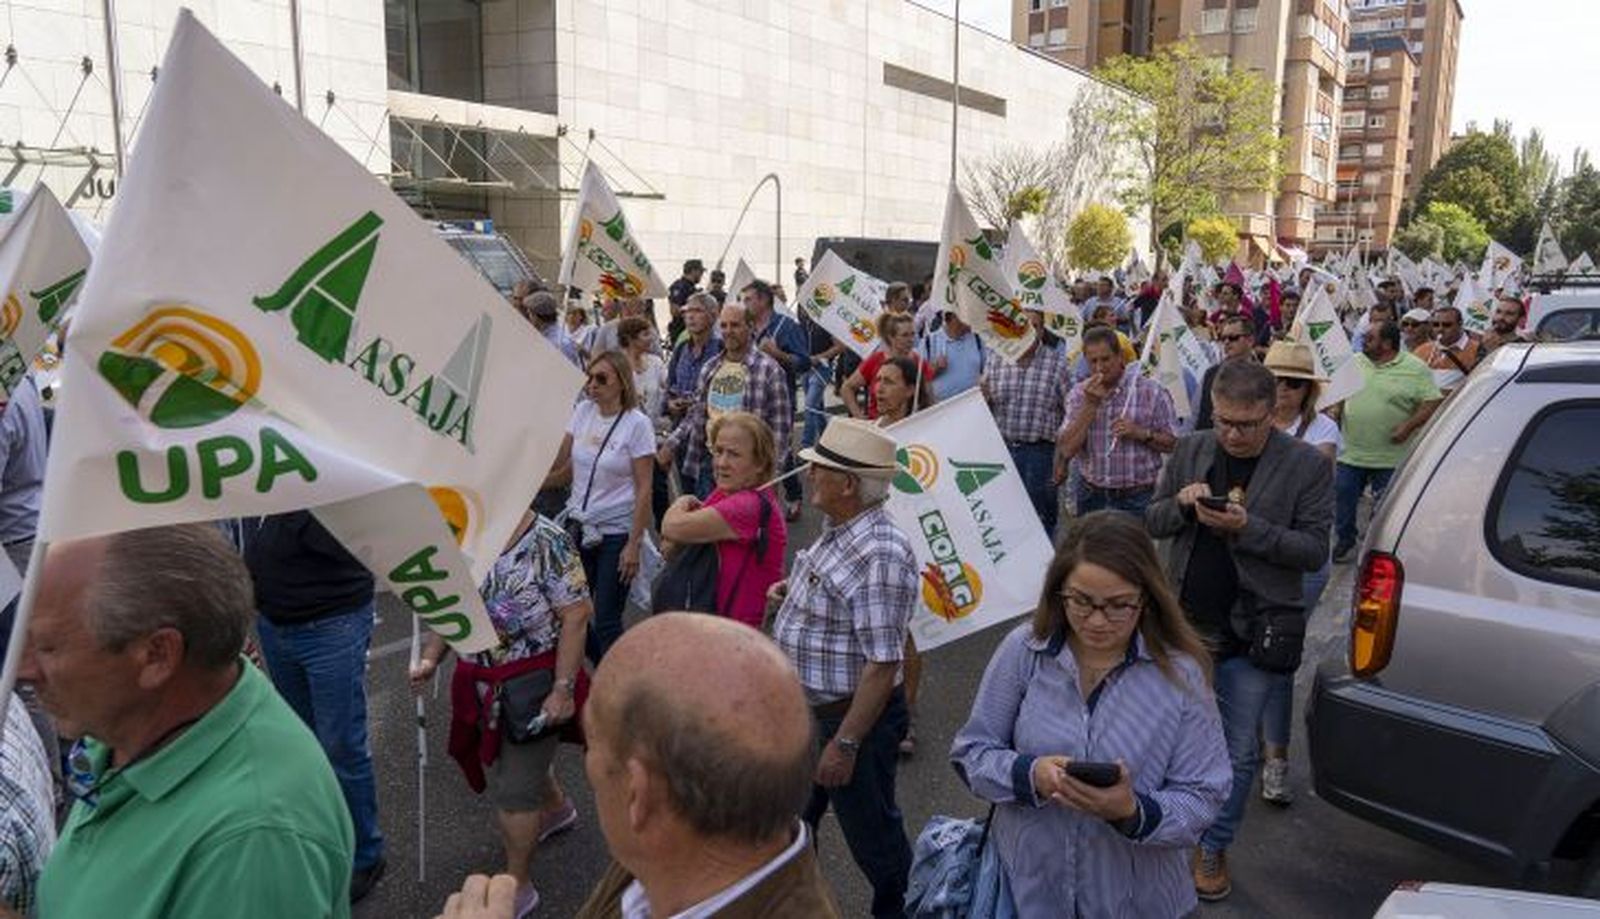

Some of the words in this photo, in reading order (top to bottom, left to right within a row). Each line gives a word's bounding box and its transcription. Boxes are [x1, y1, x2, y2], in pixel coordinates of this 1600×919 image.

[968, 275, 1030, 326] COAG
[1014, 289, 1043, 306] UPA
[349, 337, 475, 448] ASAJA
[116, 427, 318, 503] UPA
[918, 509, 976, 610] COAG
[967, 497, 1006, 565] ASAJA
[388, 545, 472, 642] UPA
